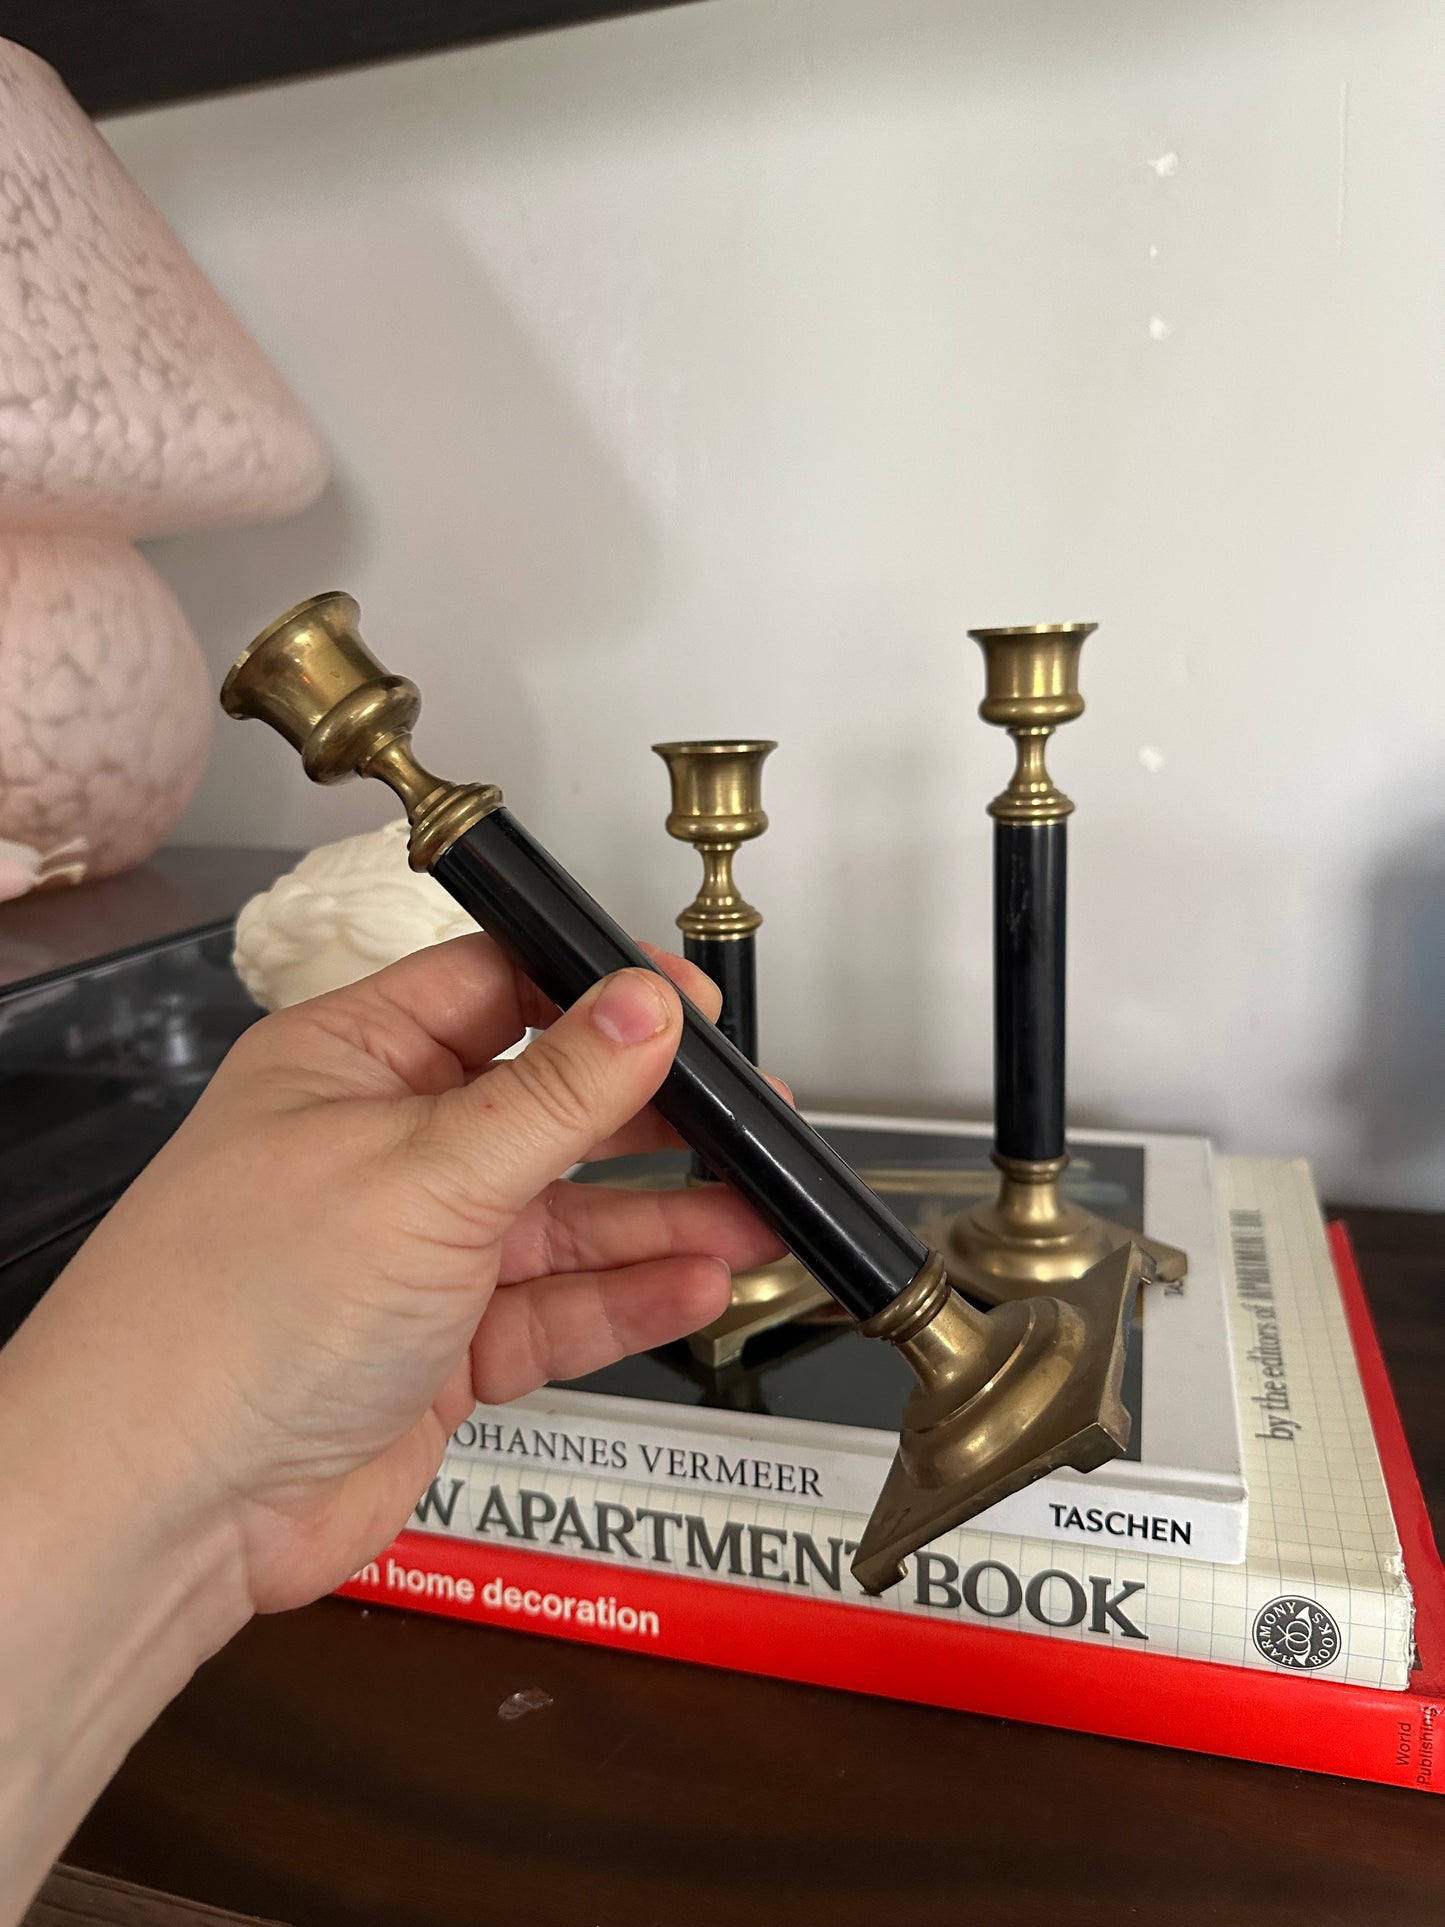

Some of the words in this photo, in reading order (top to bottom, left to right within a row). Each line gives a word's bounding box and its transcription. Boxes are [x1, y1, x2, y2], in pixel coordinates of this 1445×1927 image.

[1241, 1302, 1276, 1319] of
[1246, 1321, 1284, 1378] editors
[1250, 1379, 1289, 1412] the
[1255, 1414, 1302, 1441] by
[447, 1420, 627, 1469] OHANNES
[637, 1444, 823, 1497] VERMEER
[1048, 1502, 1192, 1546] TASCHEN
[475, 1484, 882, 1598] APARTMEN
[912, 1551, 1149, 1641] BOOK
[386, 1557, 475, 1601] home
[481, 1576, 661, 1637] decoration
[1258, 1601, 1296, 1665] HARMONY
[1308, 1612, 1335, 1666] BOOKS
[1396, 1722, 1411, 1766] World
[1416, 1706, 1438, 1785] Publishing
